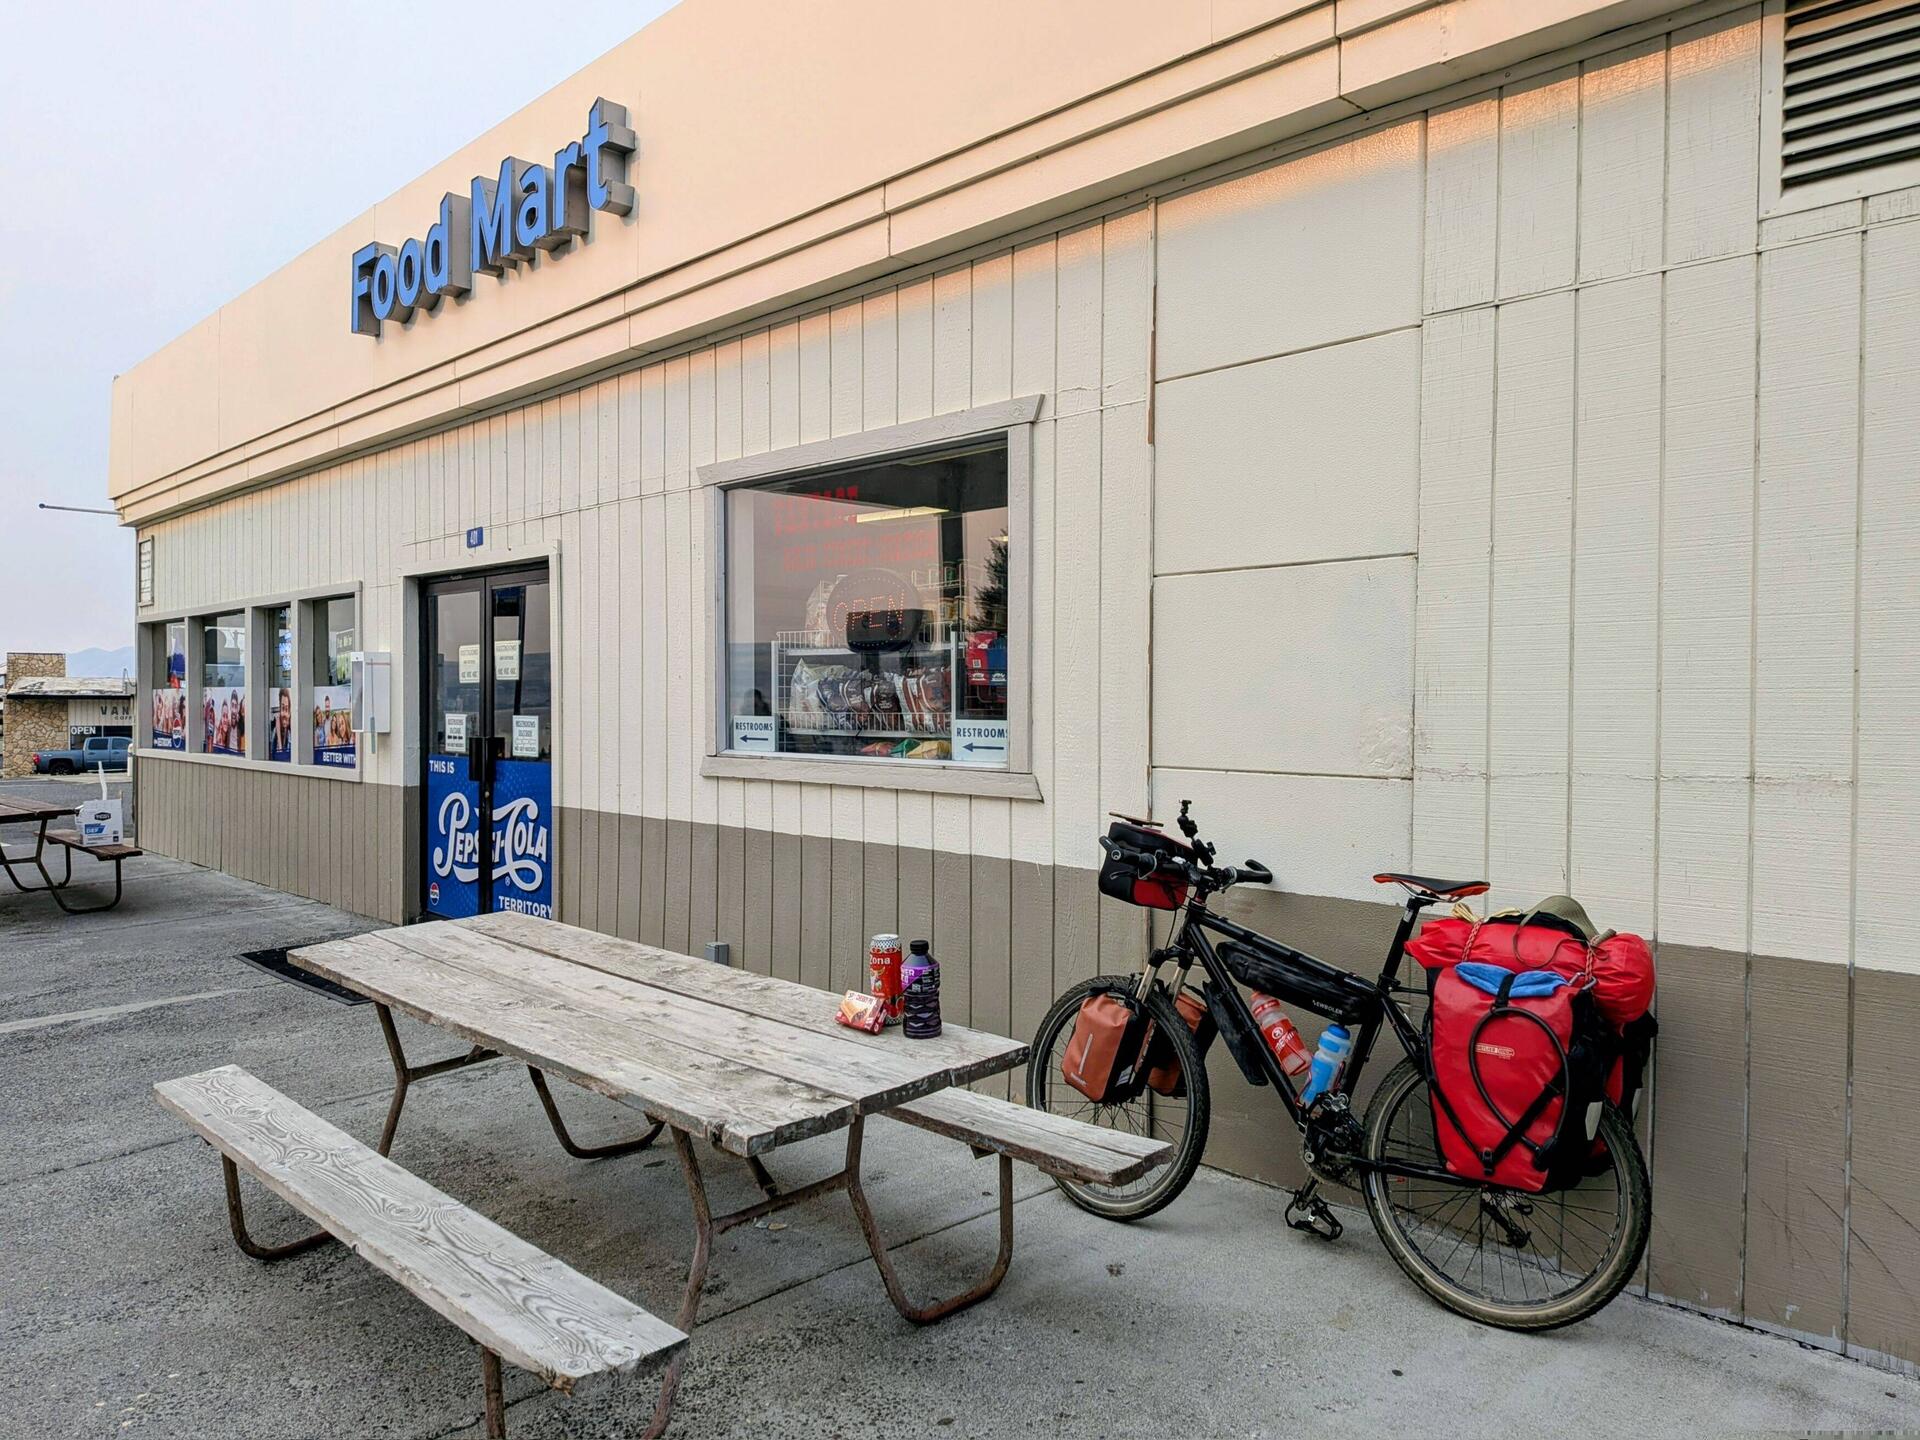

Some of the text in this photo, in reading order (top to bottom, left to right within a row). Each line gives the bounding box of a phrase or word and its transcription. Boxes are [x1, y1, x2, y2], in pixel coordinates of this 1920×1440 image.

[351, 96, 608, 334] Food Mart
[833, 589, 905, 632] OPEN
[70, 726, 97, 735] OPEN
[735, 722, 773, 731] RESTROOMS
[322, 751, 343, 764] BETTER
[429, 760, 455, 774] THIS IS
[498, 895, 552, 919] TERRITORY
